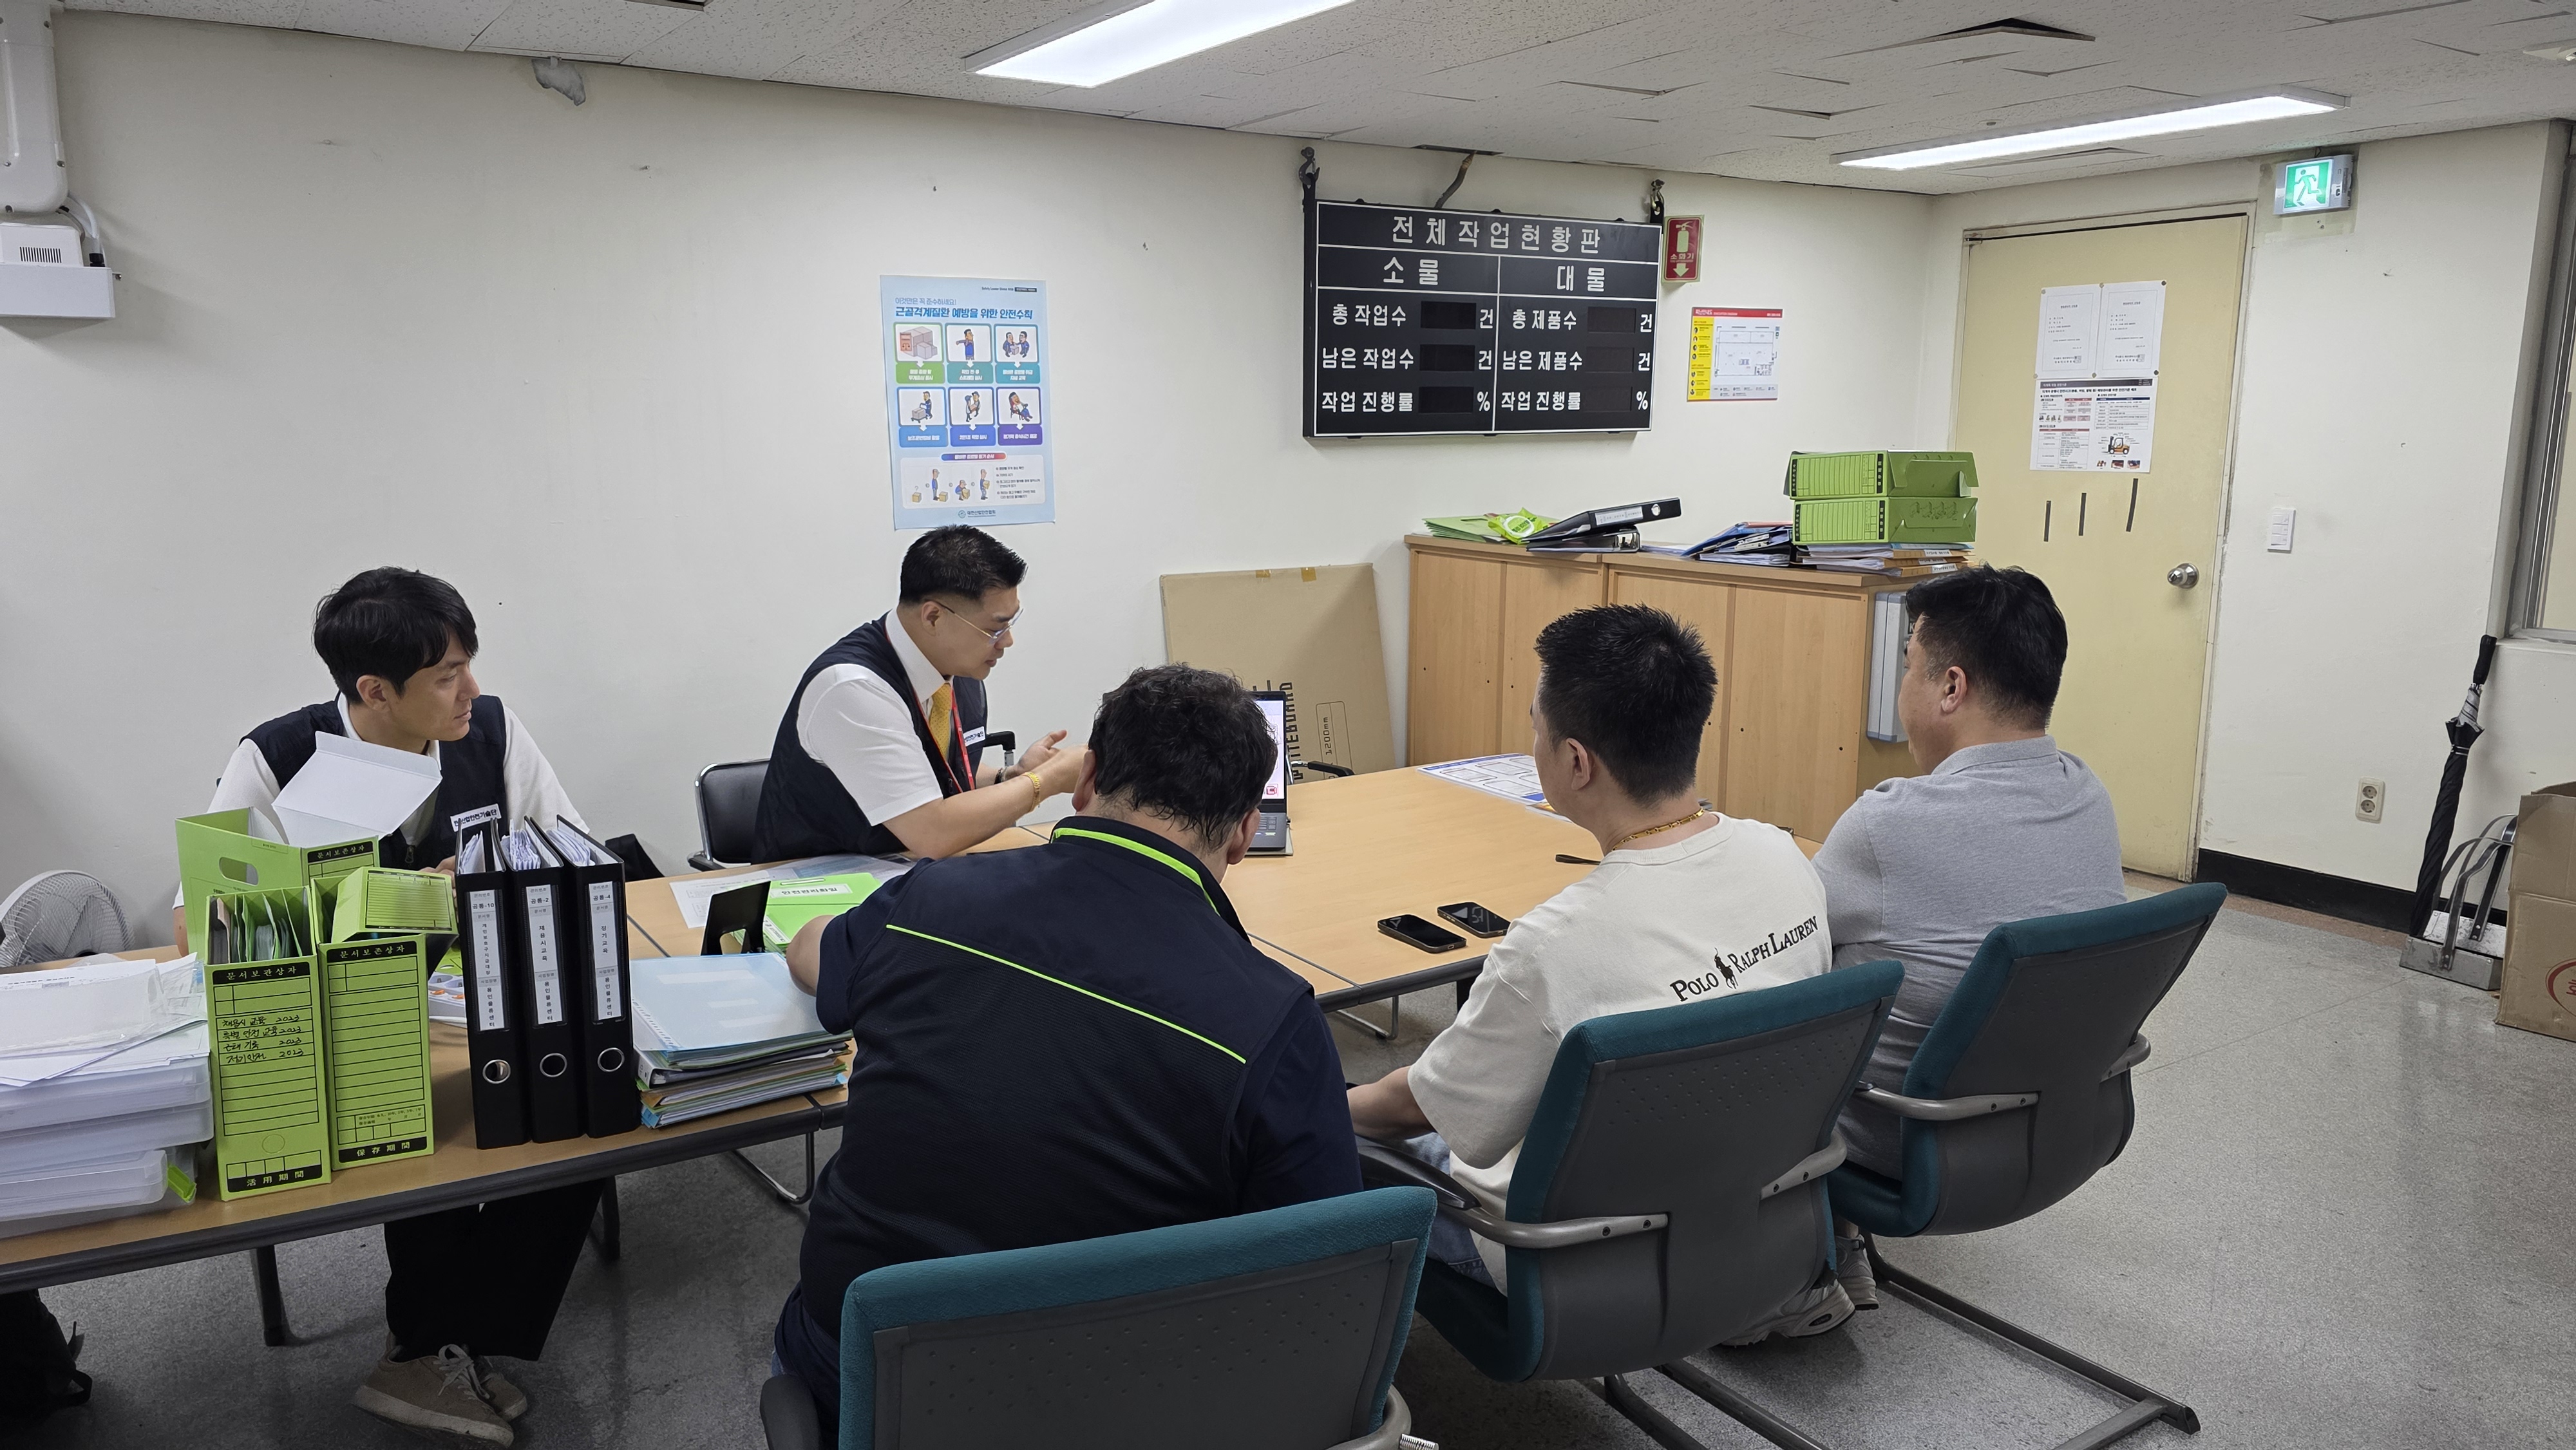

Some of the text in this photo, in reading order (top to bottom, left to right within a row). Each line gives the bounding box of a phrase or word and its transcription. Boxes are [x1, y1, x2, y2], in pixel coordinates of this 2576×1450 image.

[1392, 215, 1601, 254] 전체작업현황판
[1383, 256, 1439, 286] 소물
[1557, 265, 1605, 292] 대물
[895, 306, 1033, 319] 근골격계질환 예방을 위한 안전수칙
[1332, 303, 1493, 329] 총 작업수 건
[1512, 308, 1653, 333] 총 제품수 건
[1322, 347, 1492, 370] 남은 작업수 건
[1502, 350, 1651, 372] 남은 제품수 건
[1321, 391, 1491, 413] 작업 진행률 %
[1501, 390, 1648, 411] 작업 진행률 %
[1323, 717, 1333, 755] 1200mm
[339, 945, 405, 959] 문서보존상자
[1670, 916, 1819, 1002] POLO RALPH LAUREN
[226, 966, 297, 981] 문서보관상자
[279, 1048, 303, 1058] 2023
[356, 1142, 410, 1157] 保存期間
[247, 1170, 304, 1187] 活用期間
